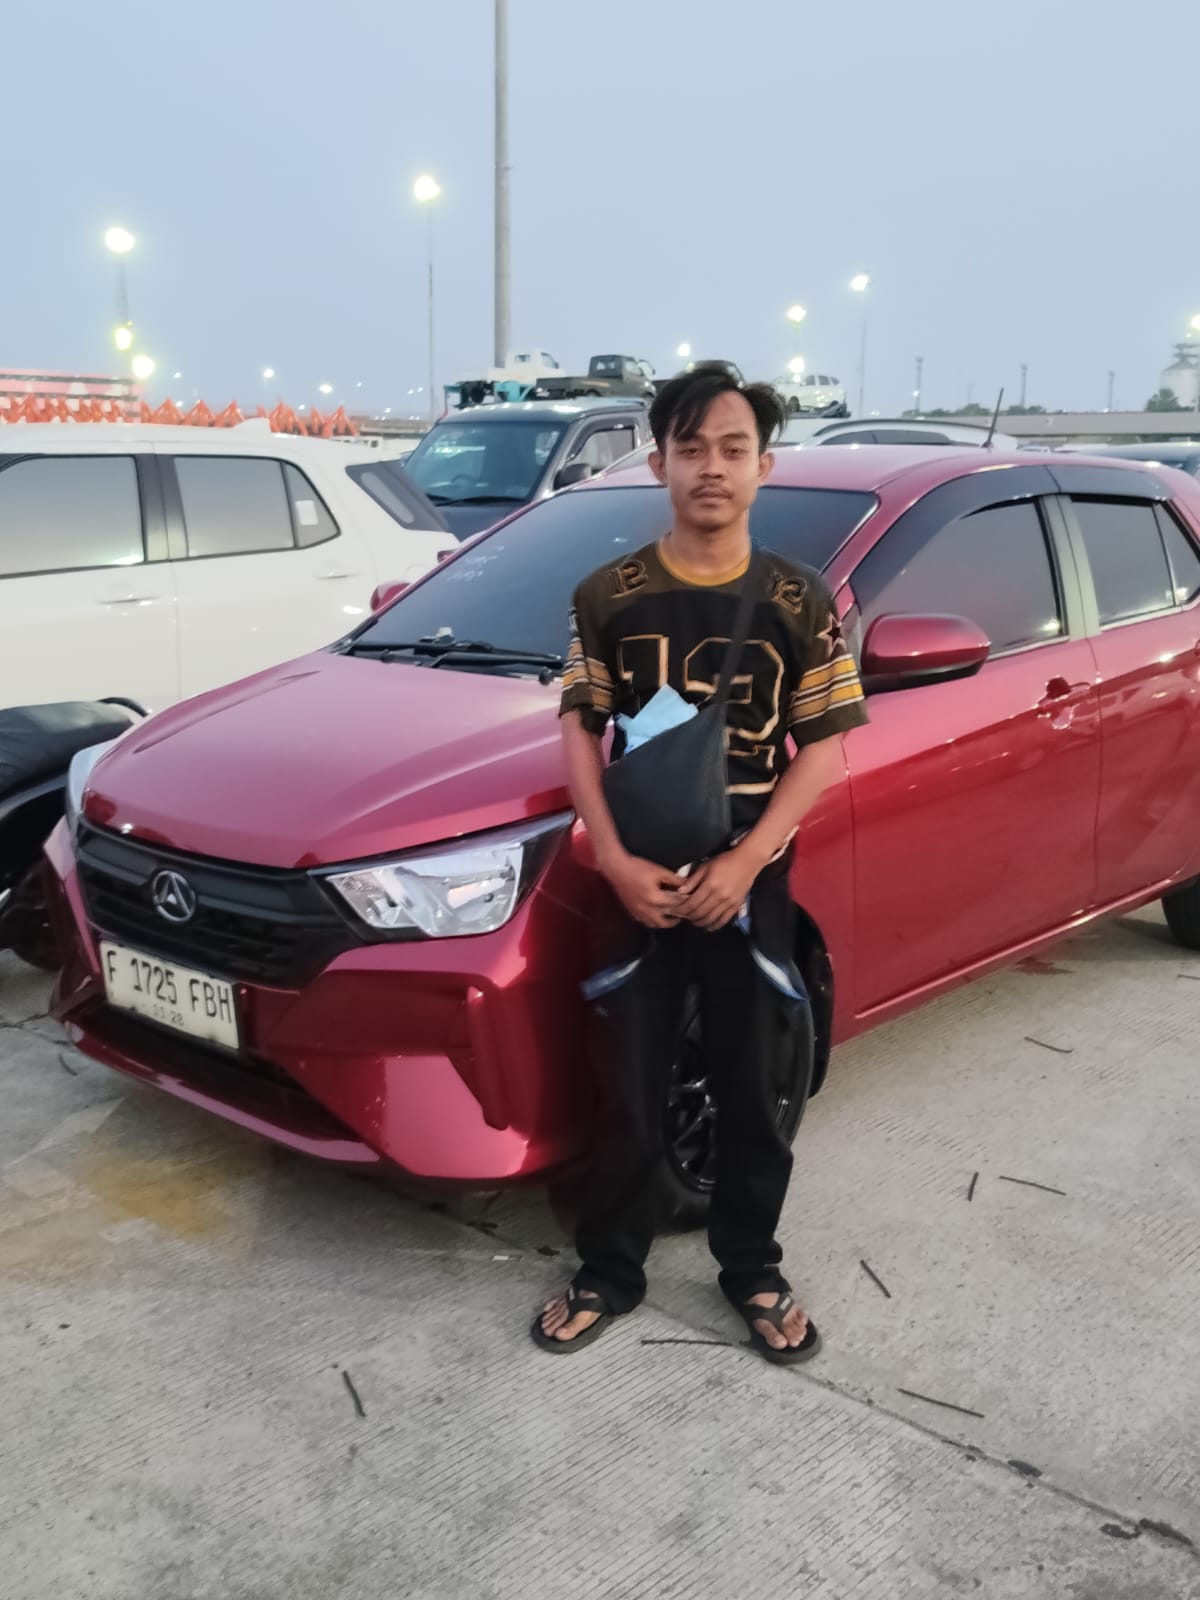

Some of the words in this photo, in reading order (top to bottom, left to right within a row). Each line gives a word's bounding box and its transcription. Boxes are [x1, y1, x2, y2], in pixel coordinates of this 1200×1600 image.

[107, 950, 117, 982] F
[131, 957, 177, 1005] 1725
[189, 978, 232, 1024] FBH
